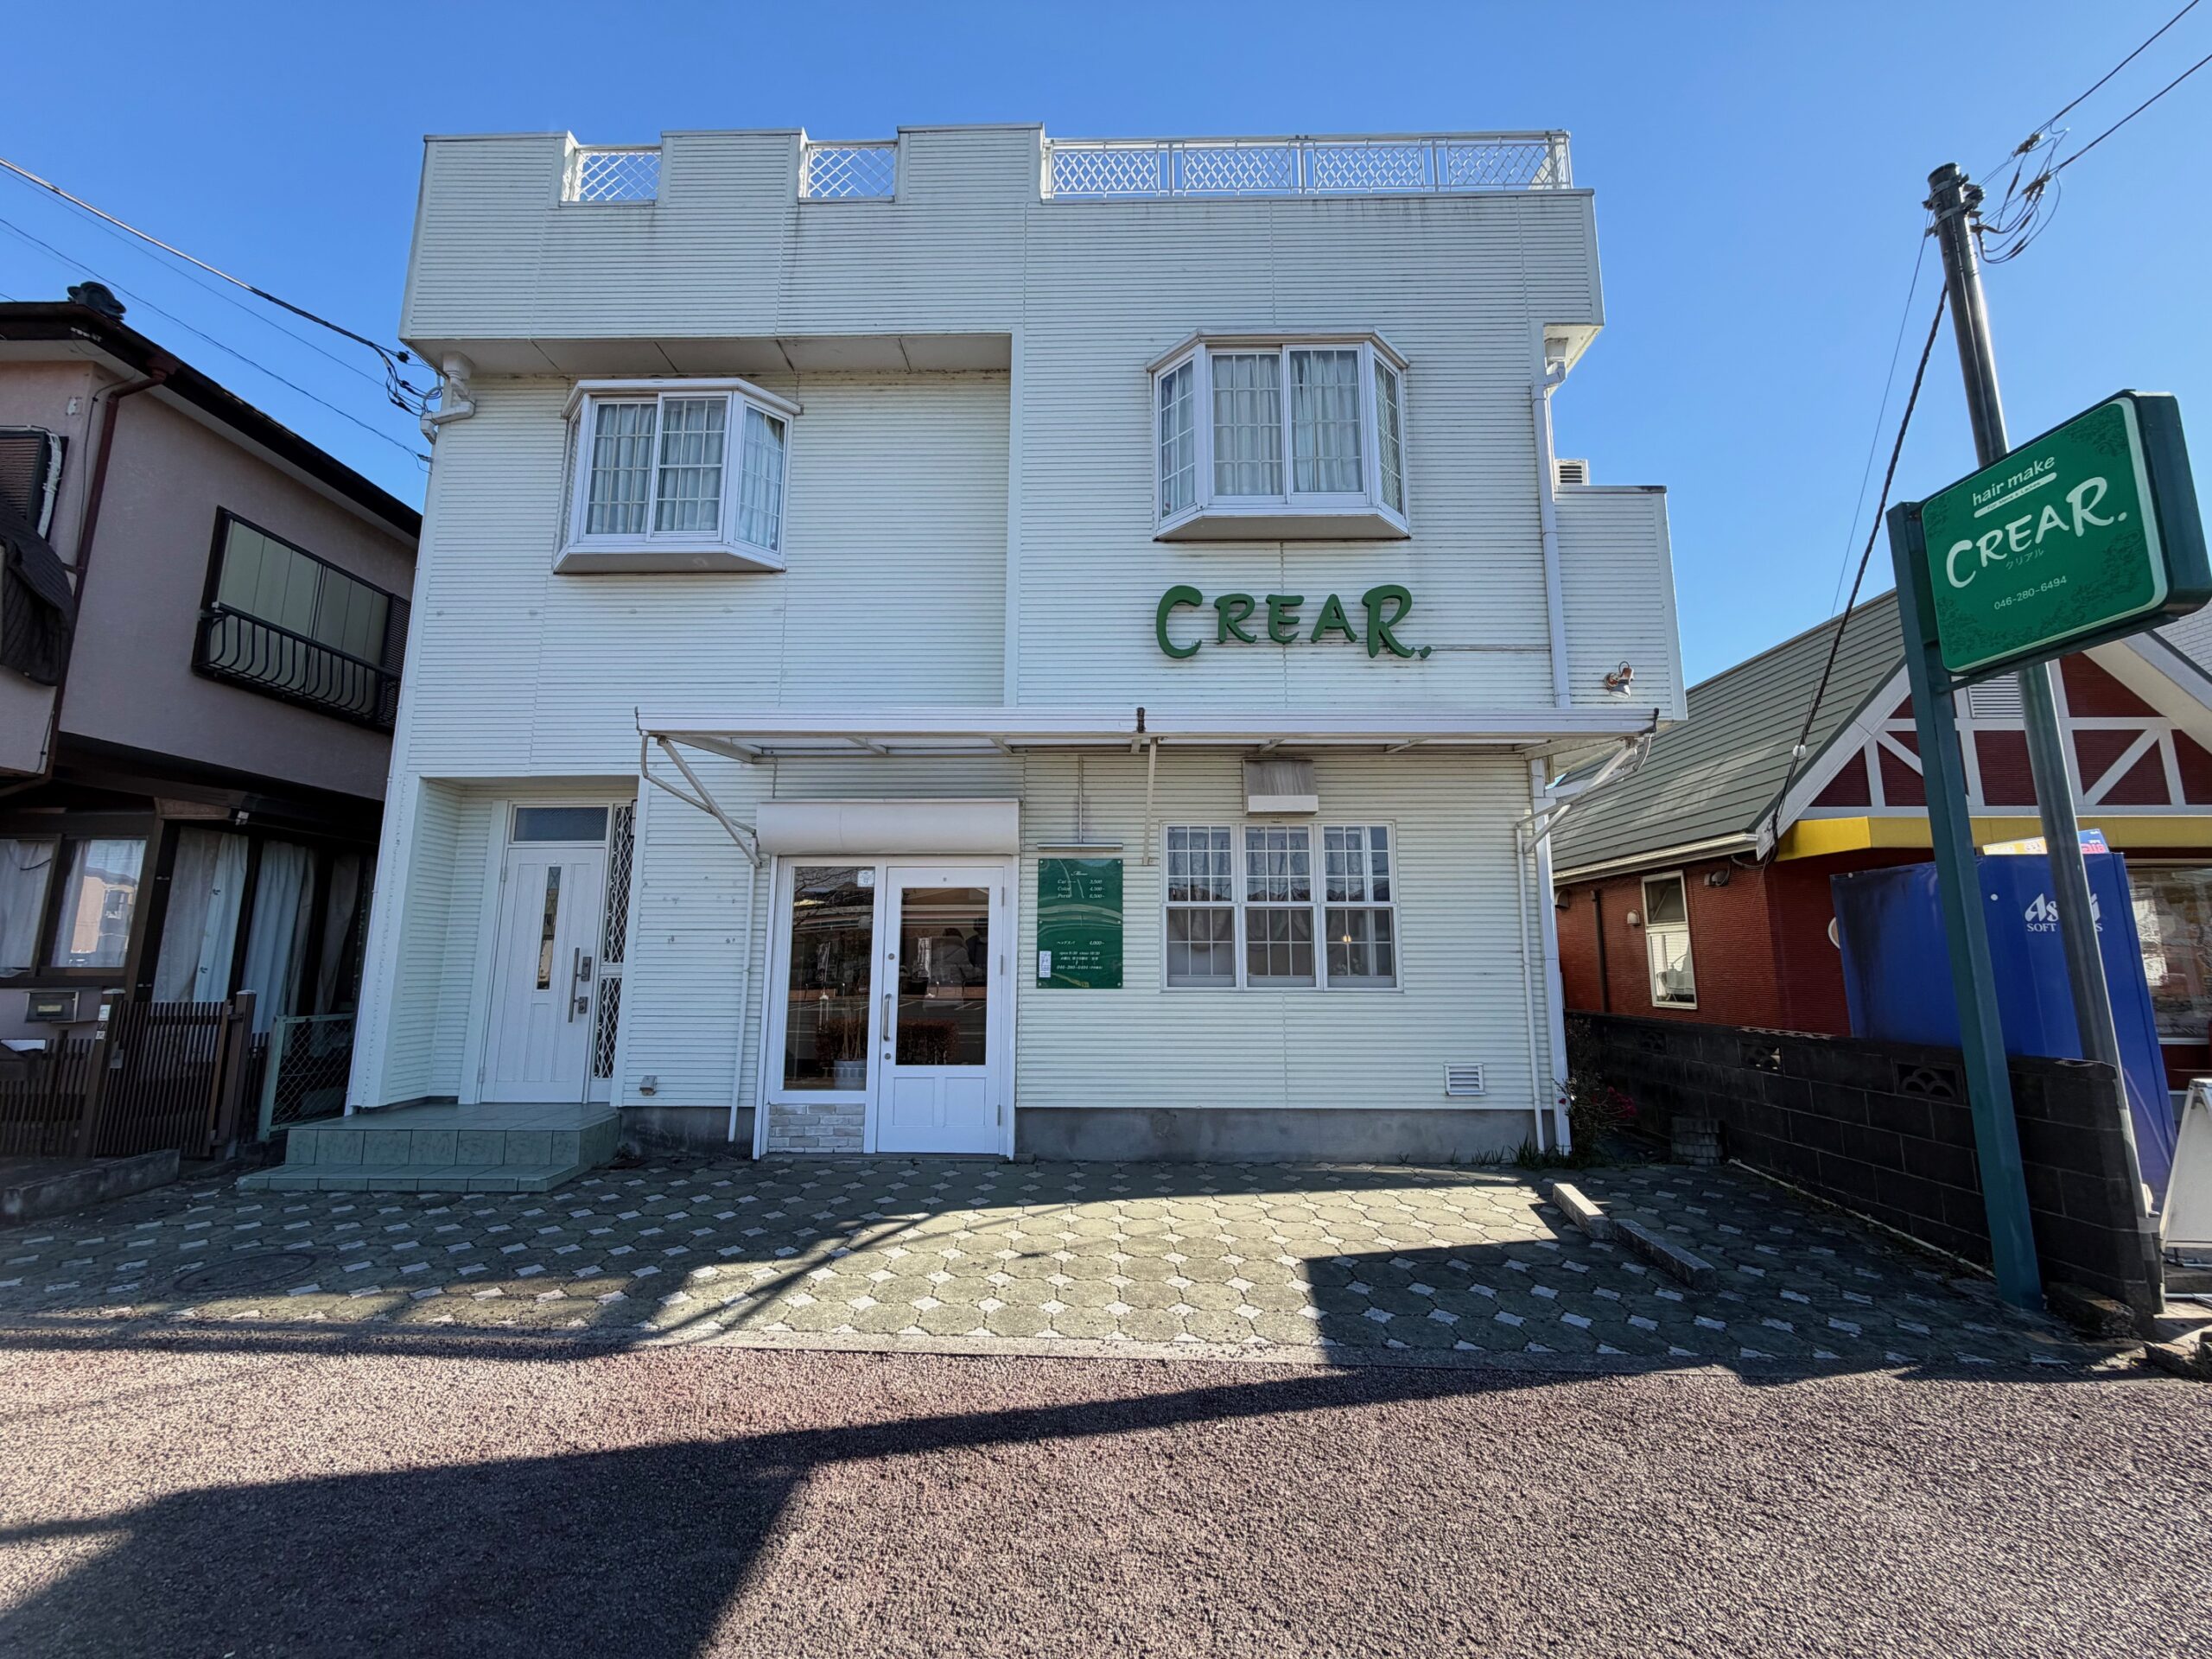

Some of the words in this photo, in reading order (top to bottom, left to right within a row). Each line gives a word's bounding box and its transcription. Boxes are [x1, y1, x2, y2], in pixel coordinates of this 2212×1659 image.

[1973, 481, 2005, 506] hair
[2007, 456, 2055, 489] make
[2005, 548, 2044, 570] クリアル
[1993, 575, 2068, 610] 046-280-6494
[2024, 893, 2101, 922] Asi
[2026, 923, 2056, 932] SOFT
